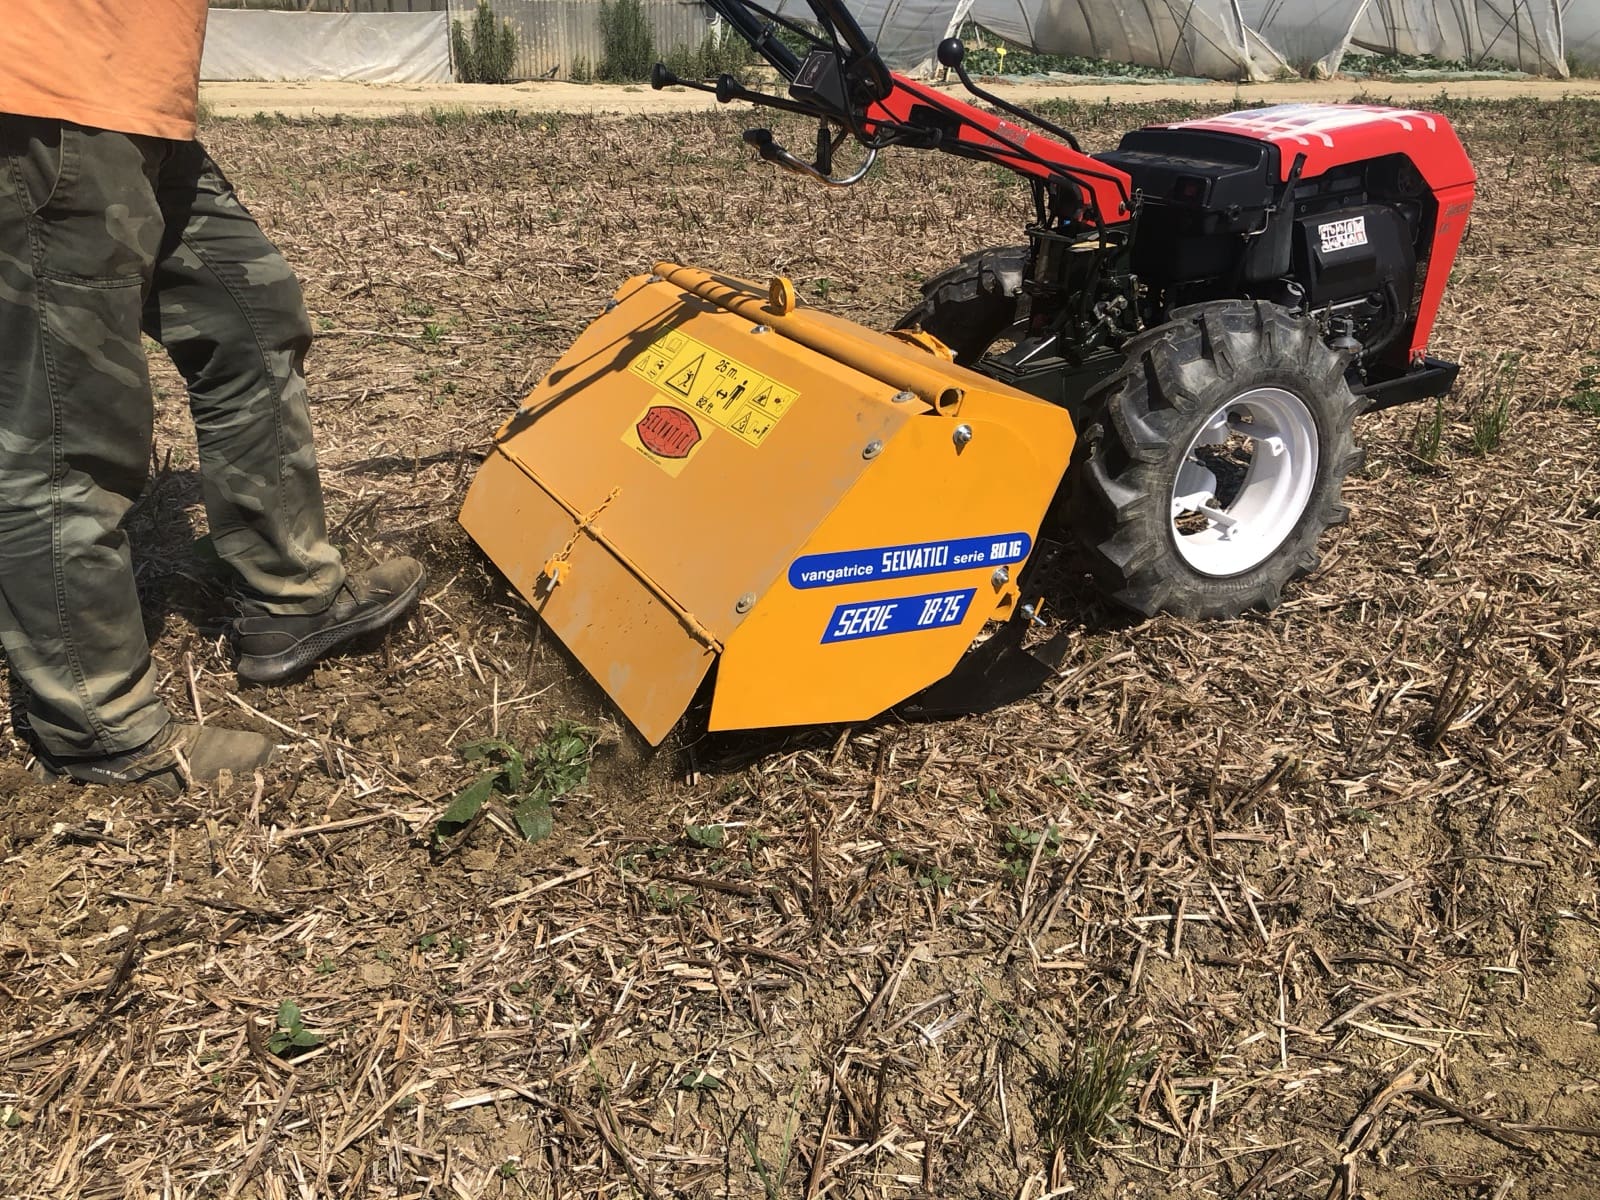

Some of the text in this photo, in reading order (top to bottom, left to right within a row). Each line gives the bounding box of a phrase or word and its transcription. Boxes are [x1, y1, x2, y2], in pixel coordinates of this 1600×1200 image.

[715, 360, 730, 373] 25
[696, 396, 708, 409] 82
[641, 411, 694, 453] SELVATICI
[801, 540, 1022, 582] vangatrice SELVATICI serie 80.16
[833, 604, 899, 637] SERIE
